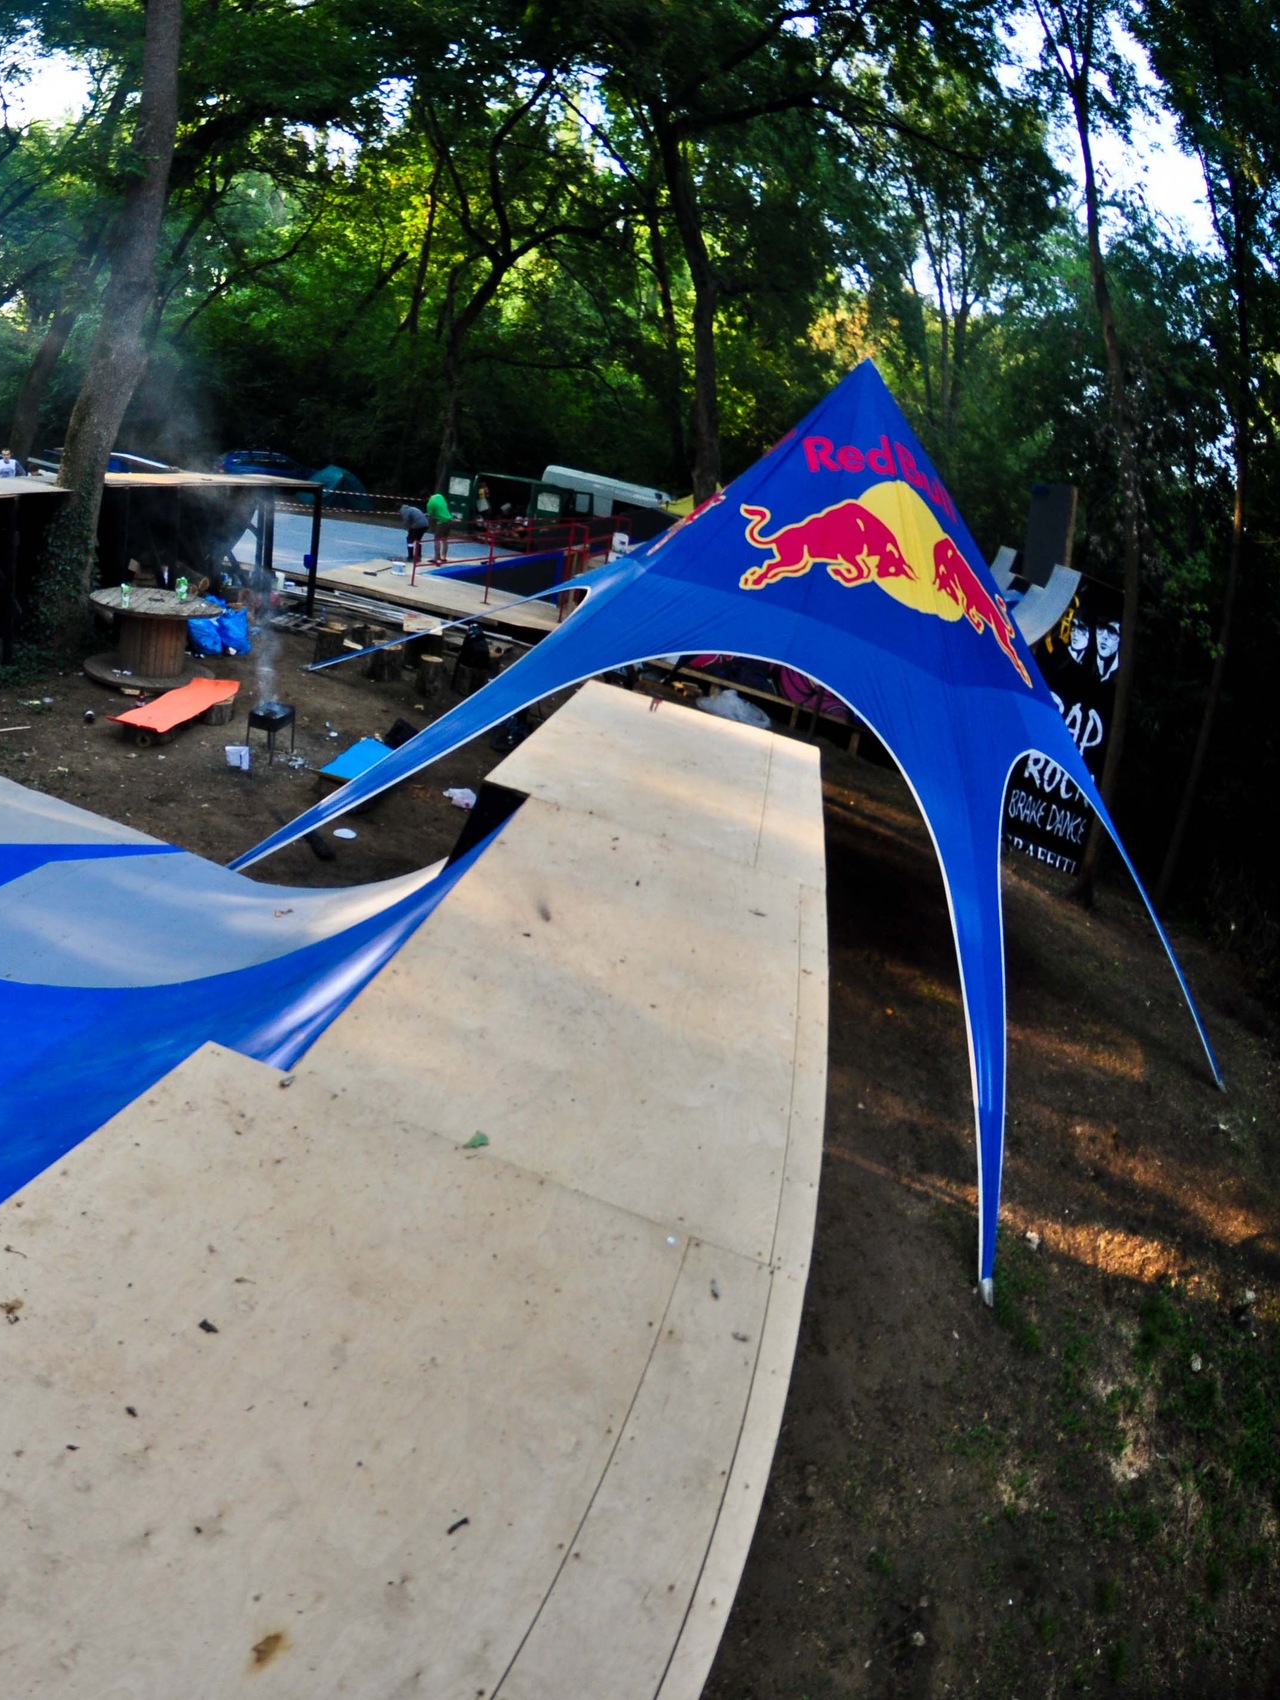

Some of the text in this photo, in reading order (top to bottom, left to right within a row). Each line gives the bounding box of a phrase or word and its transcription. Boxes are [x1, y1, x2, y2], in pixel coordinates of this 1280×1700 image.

[803, 435, 897, 476] Red
[1008, 789, 1087, 845] BRAKE DANCE
